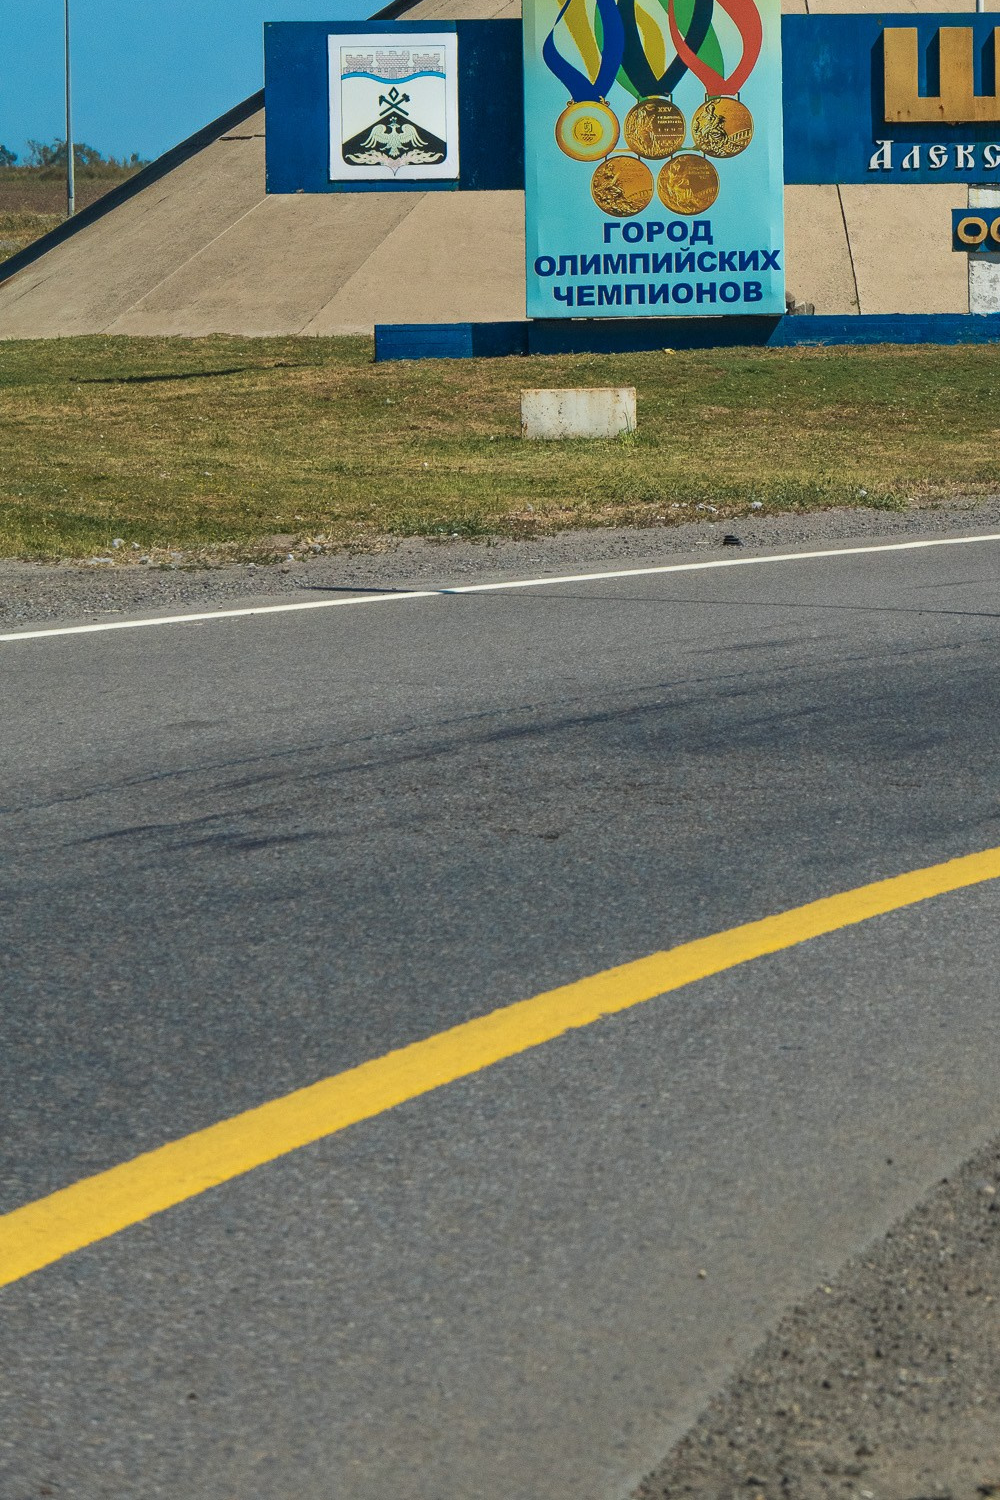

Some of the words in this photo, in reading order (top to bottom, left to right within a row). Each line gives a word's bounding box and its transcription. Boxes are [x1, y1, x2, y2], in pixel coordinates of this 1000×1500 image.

[603, 220, 714, 246] ГОРОД
[533, 246, 782, 277] ОЛИМПИЙСКИХ
[553, 281, 764, 307] ЧЕМПИОНОВ
